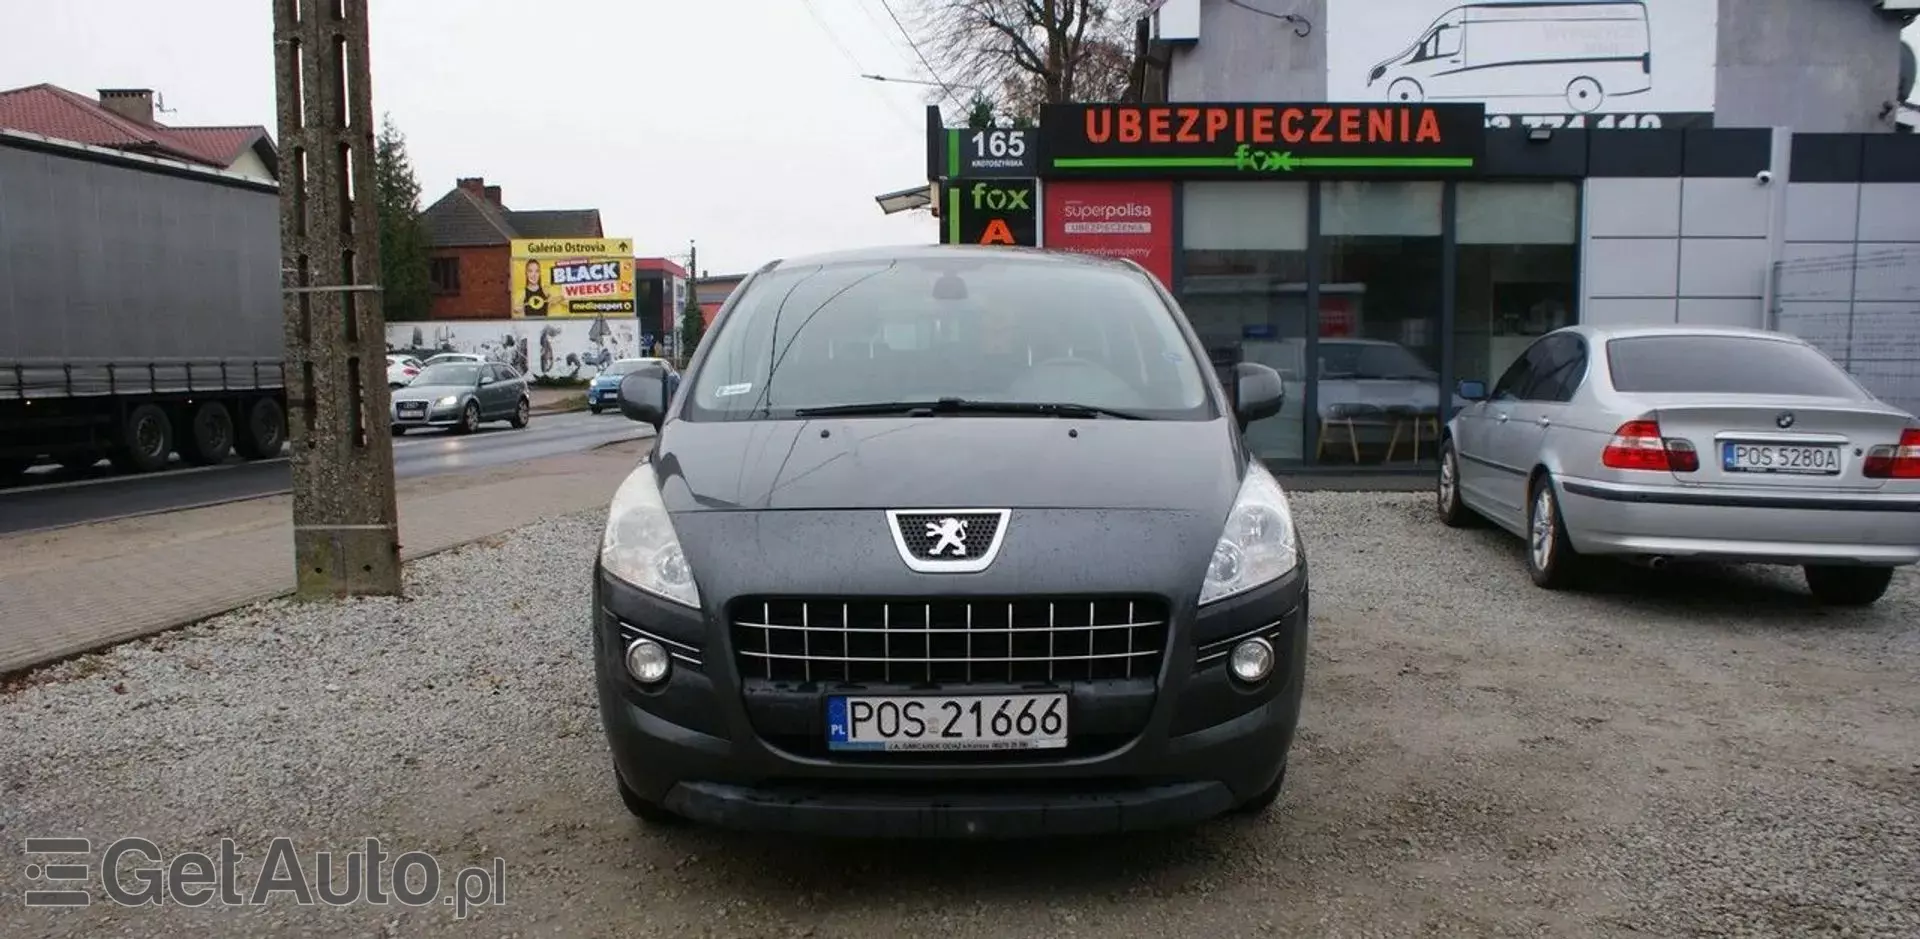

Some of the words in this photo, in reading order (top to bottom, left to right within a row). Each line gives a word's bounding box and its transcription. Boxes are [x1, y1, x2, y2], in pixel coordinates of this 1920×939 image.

[1086, 108, 1442, 143] UBEZPIECZENIA
[971, 131, 1025, 157] 165
[1234, 144, 1294, 171] fox
[971, 183, 1030, 210] fox
[1064, 203, 1152, 220] superpolisa
[528, 242, 564, 253] Galeria
[565, 242, 606, 252] Ostrovia
[553, 262, 618, 283] BLACK
[565, 282, 615, 296] WEEKS!
[1736, 447, 1773, 466] POS
[1779, 448, 1837, 468] 5280A
[850, 701, 926, 738] POS
[941, 697, 1062, 738] 21666
[830, 724, 846, 735] PL
